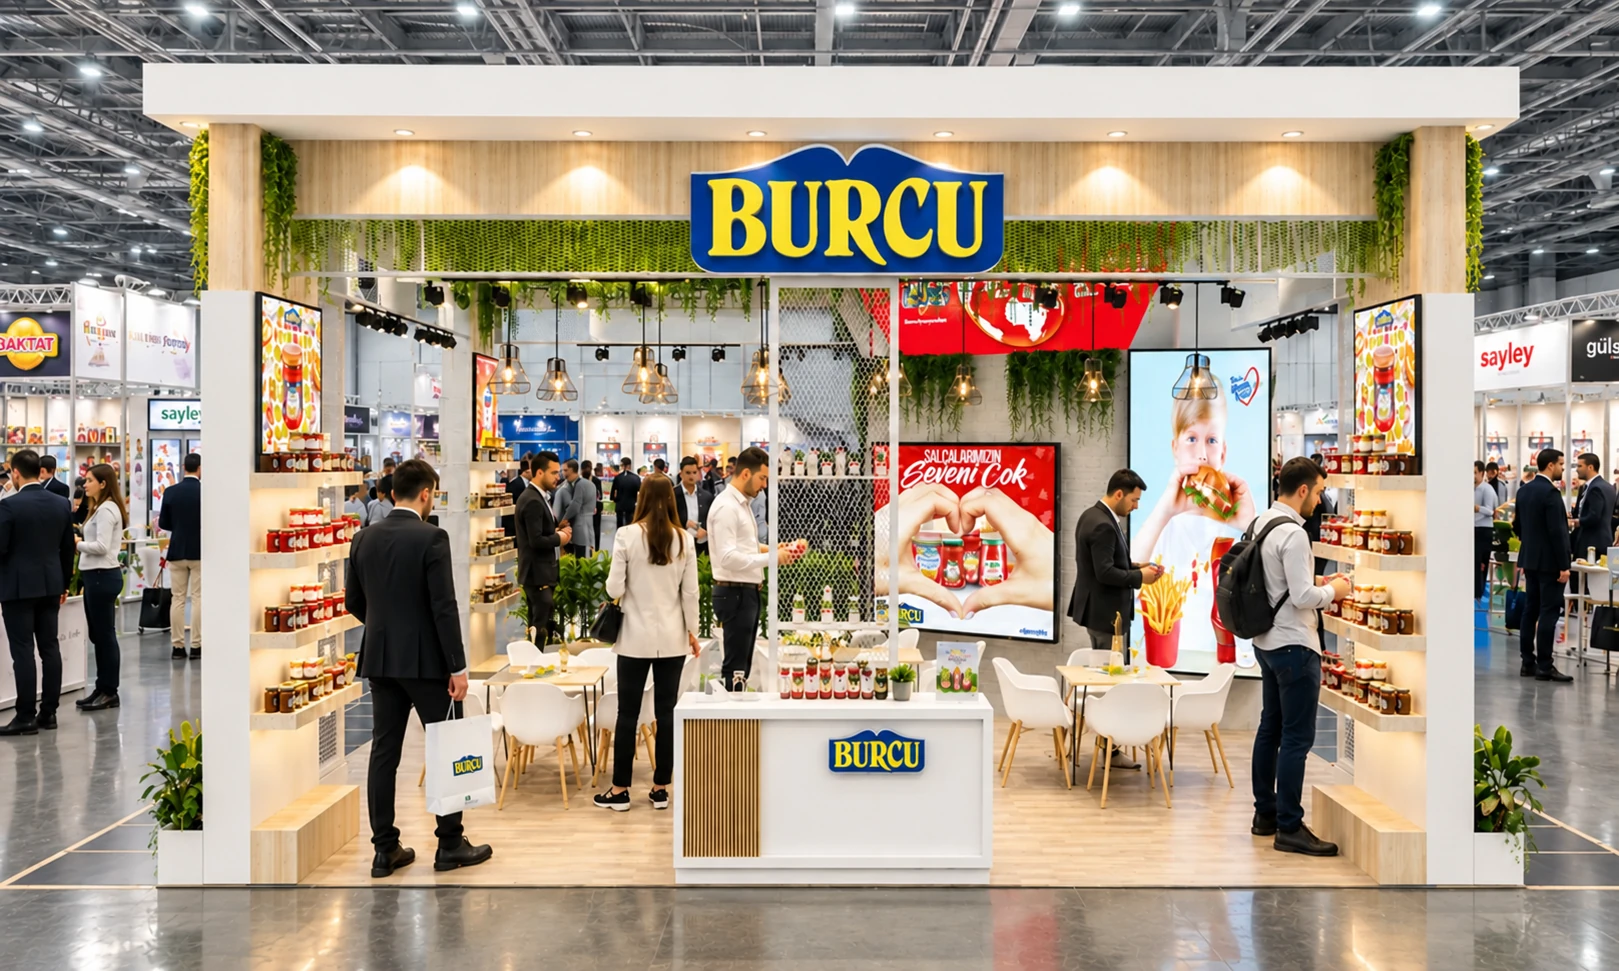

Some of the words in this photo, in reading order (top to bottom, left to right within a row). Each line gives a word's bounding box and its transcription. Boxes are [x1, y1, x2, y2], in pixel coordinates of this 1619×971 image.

[707, 178, 988, 266] BURCU
[1480, 341, 1534, 371] sayley
[900, 461, 979, 489] Seveni
[454, 757, 482, 774] BURCU
[834, 740, 920, 771] BURCU
